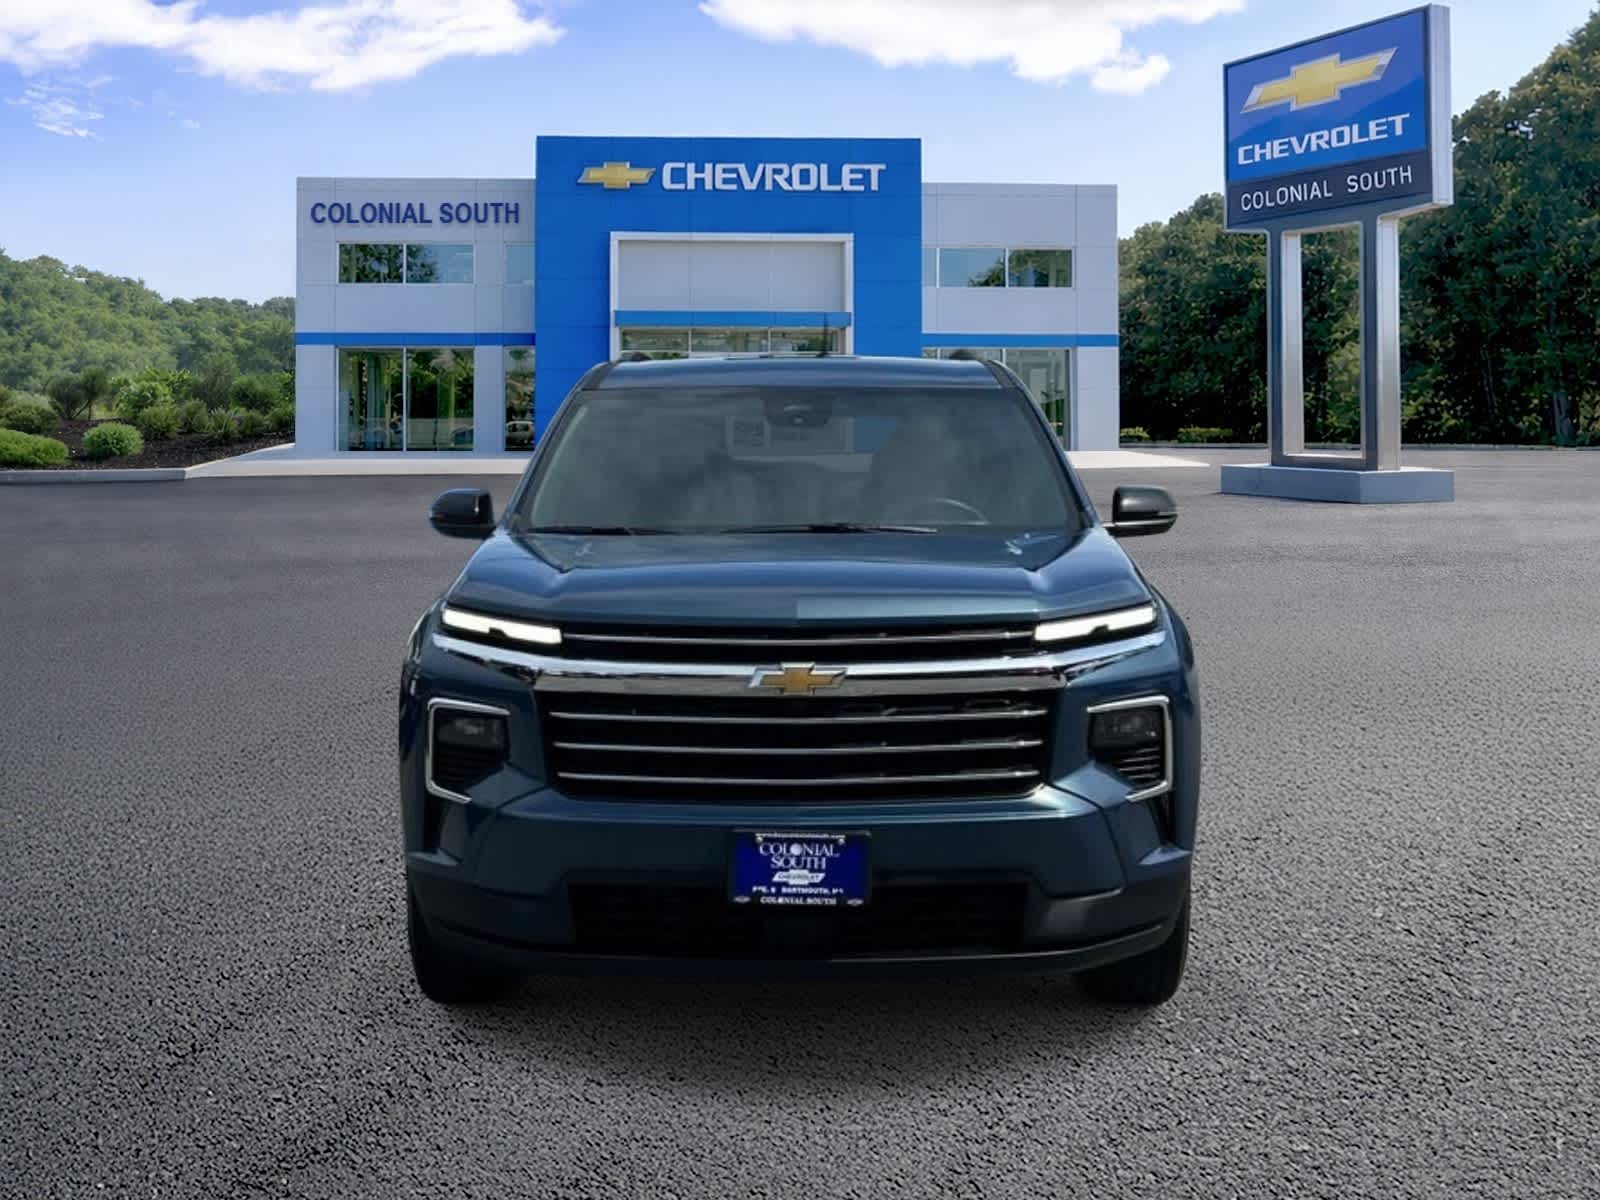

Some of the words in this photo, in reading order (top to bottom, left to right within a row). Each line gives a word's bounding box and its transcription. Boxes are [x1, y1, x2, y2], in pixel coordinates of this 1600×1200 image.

[1237, 113, 1410, 165] CHEVROLET
[661, 162, 887, 192] CHEVROLET
[1240, 180, 1333, 211] COLONIAL
[1346, 165, 1412, 194] SOUTH
[310, 202, 433, 224] COLONIAL
[439, 202, 520, 224] SOUTH
[759, 842, 839, 857] COLONIAL
[770, 856, 827, 870] SOUTH
